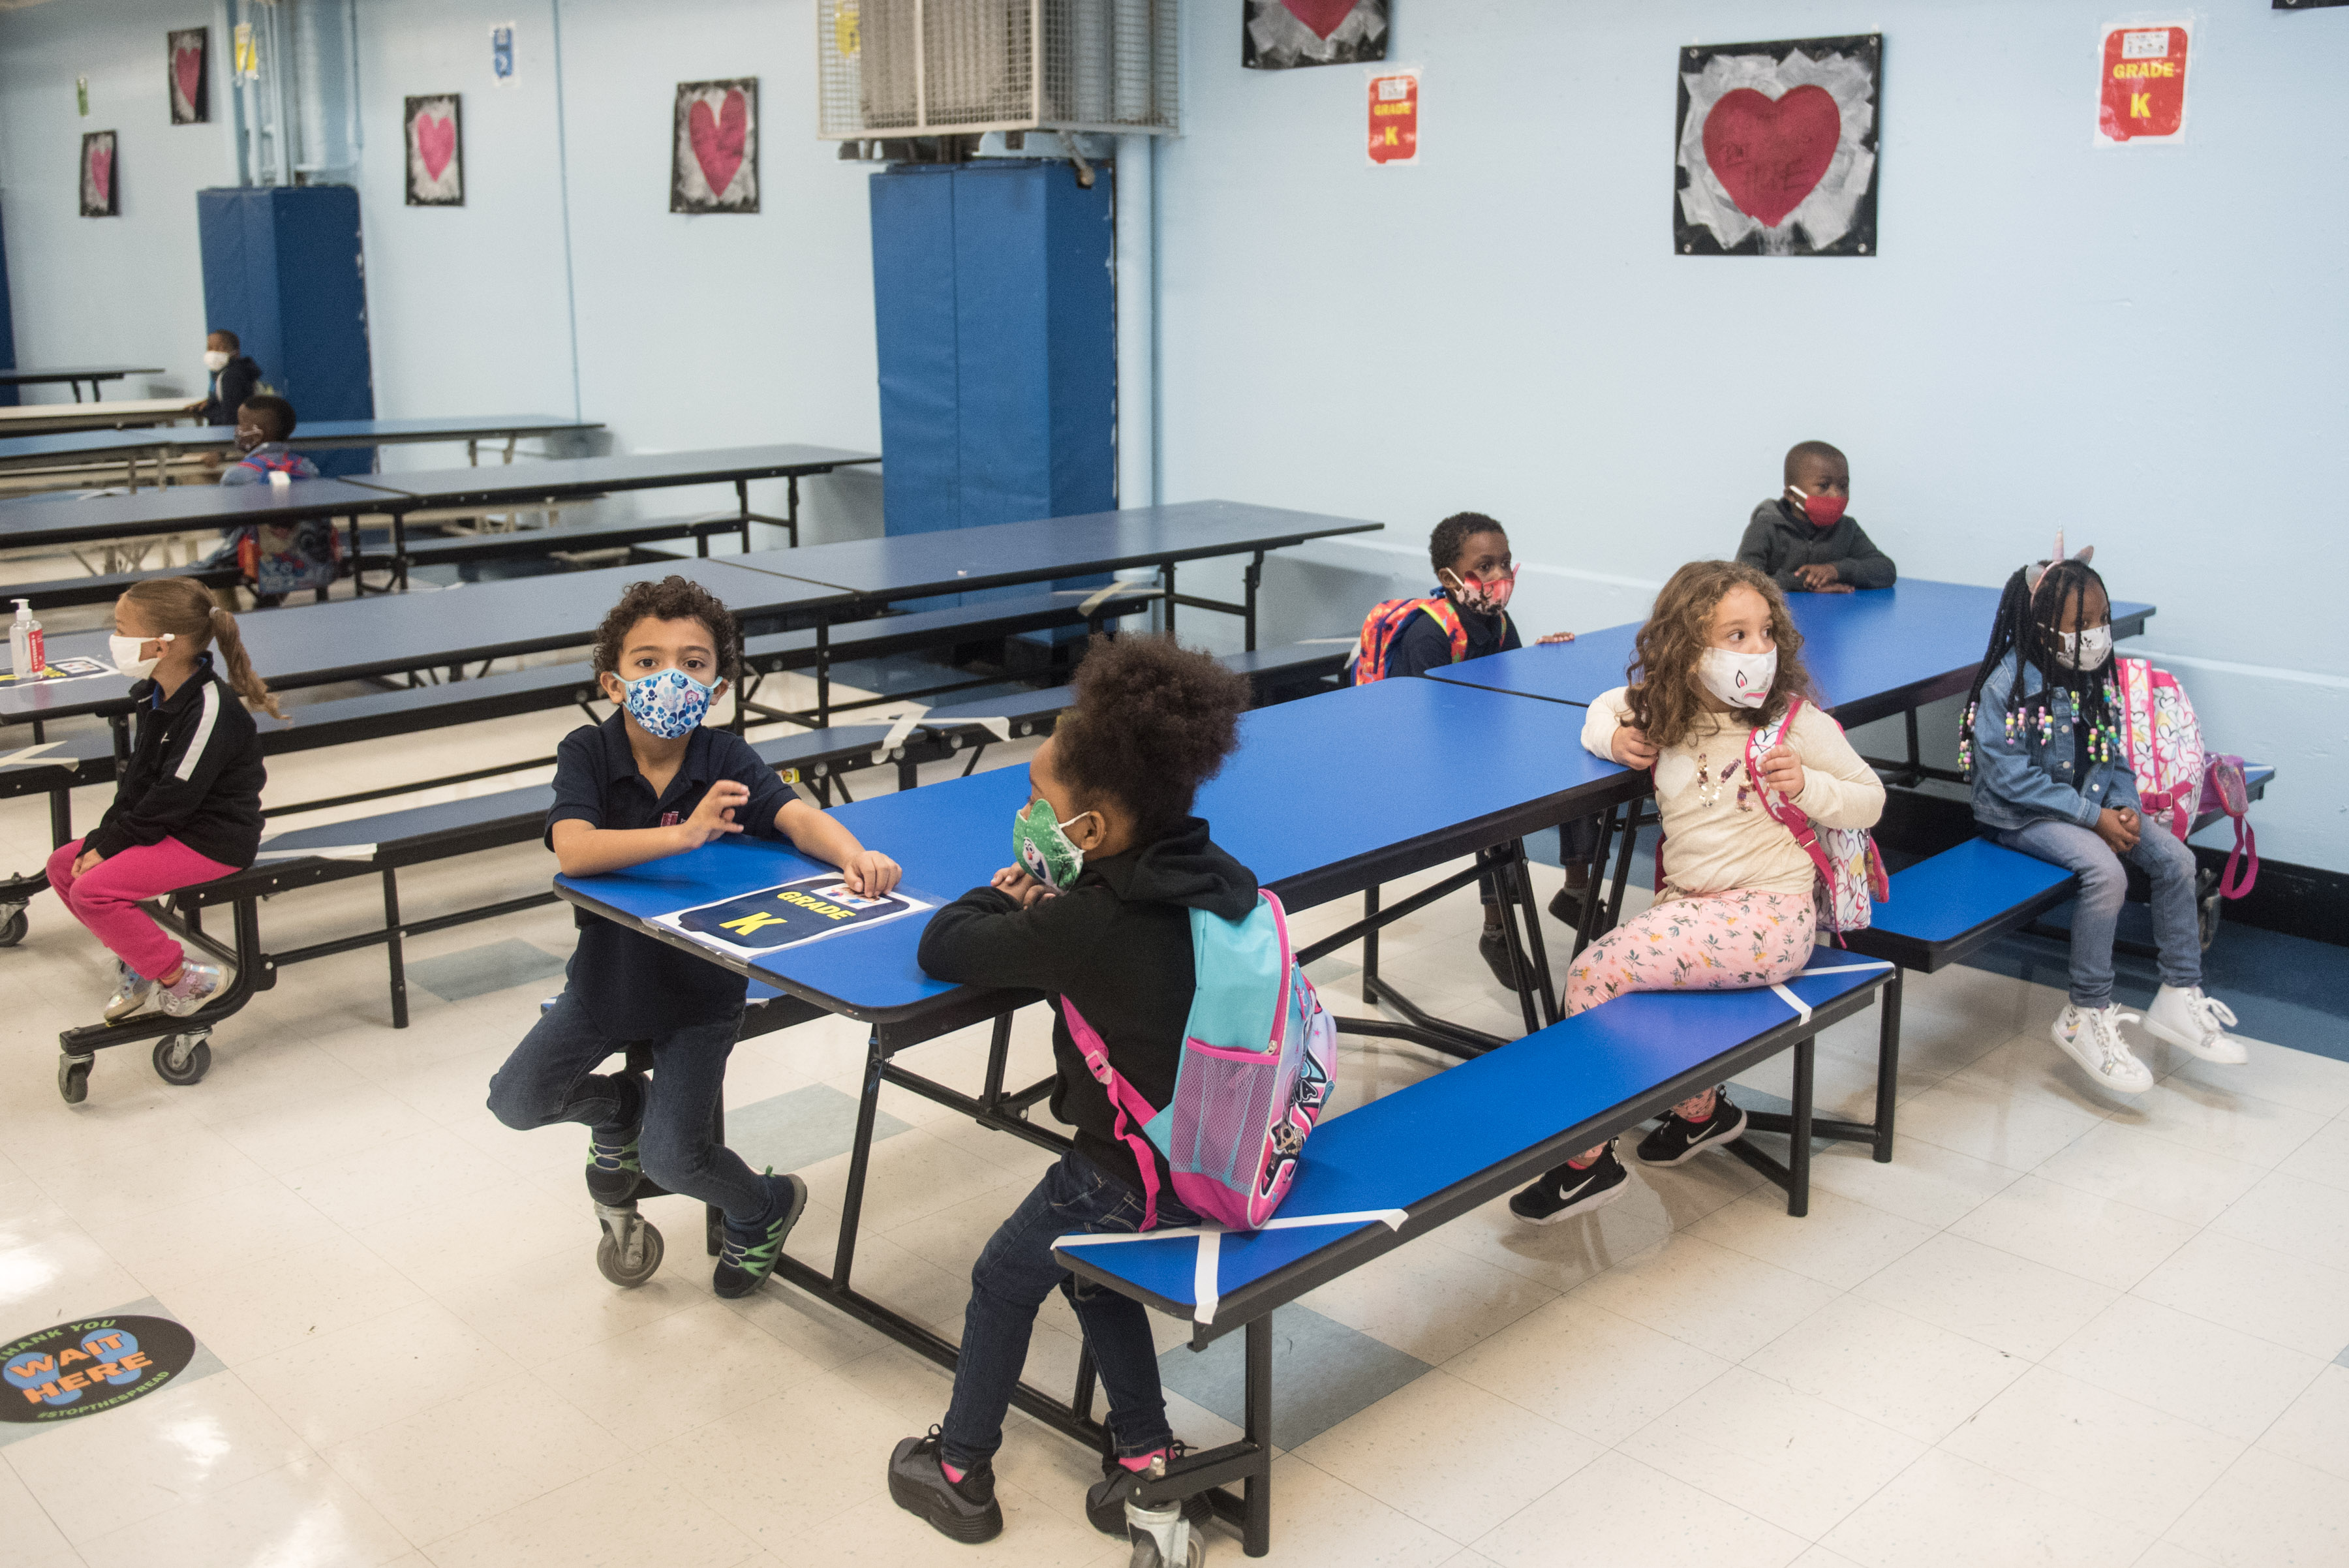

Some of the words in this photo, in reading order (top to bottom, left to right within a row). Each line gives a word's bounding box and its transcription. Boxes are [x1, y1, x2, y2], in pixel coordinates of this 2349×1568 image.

[2113, 62, 2174, 79] GRADE
[1374, 103, 1411, 116] GRADE
[2130, 93, 2151, 118] K
[1385, 126, 1398, 146] K
[777, 891, 855, 920] GRADE
[720, 912, 787, 936] K
[70, 1319, 116, 1332] YOU
[9, 1333, 122, 1377] WAIT
[23, 1351, 153, 1404] HERE
[37, 1371, 169, 1419] #STOPTHESPREAD
